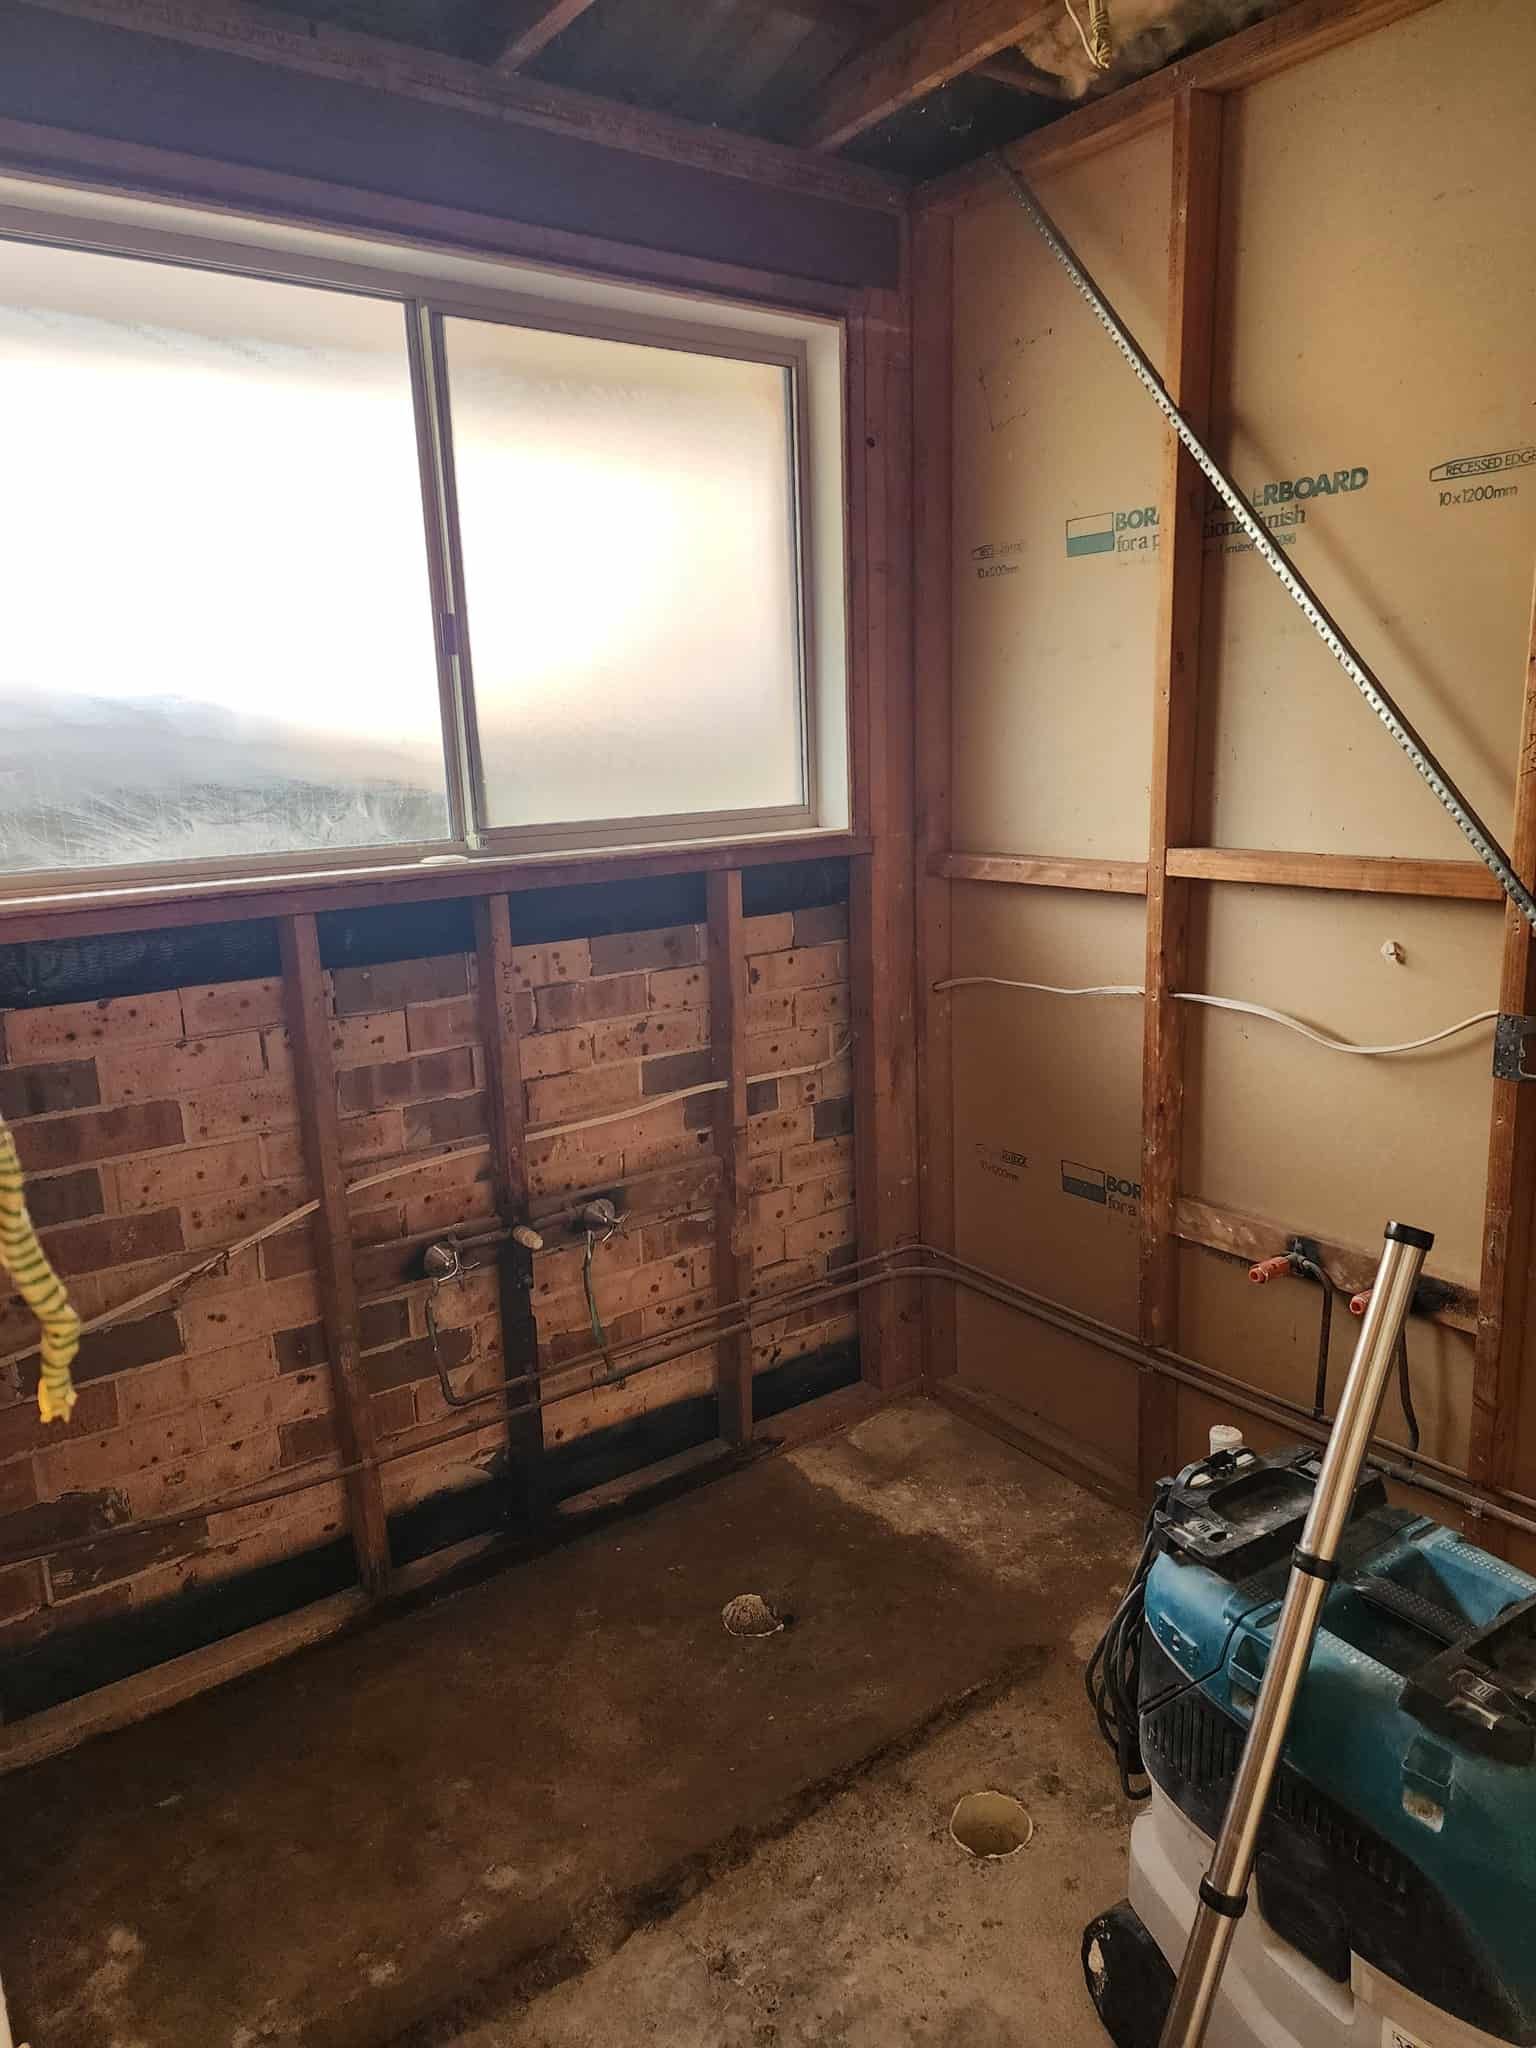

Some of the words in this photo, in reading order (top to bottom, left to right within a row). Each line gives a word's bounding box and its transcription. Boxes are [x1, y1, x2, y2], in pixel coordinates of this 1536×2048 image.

[1446, 456, 1503, 477] RECESSED
[1439, 485, 1519, 507] 10x1200mm
[1259, 503, 1307, 529] inish
